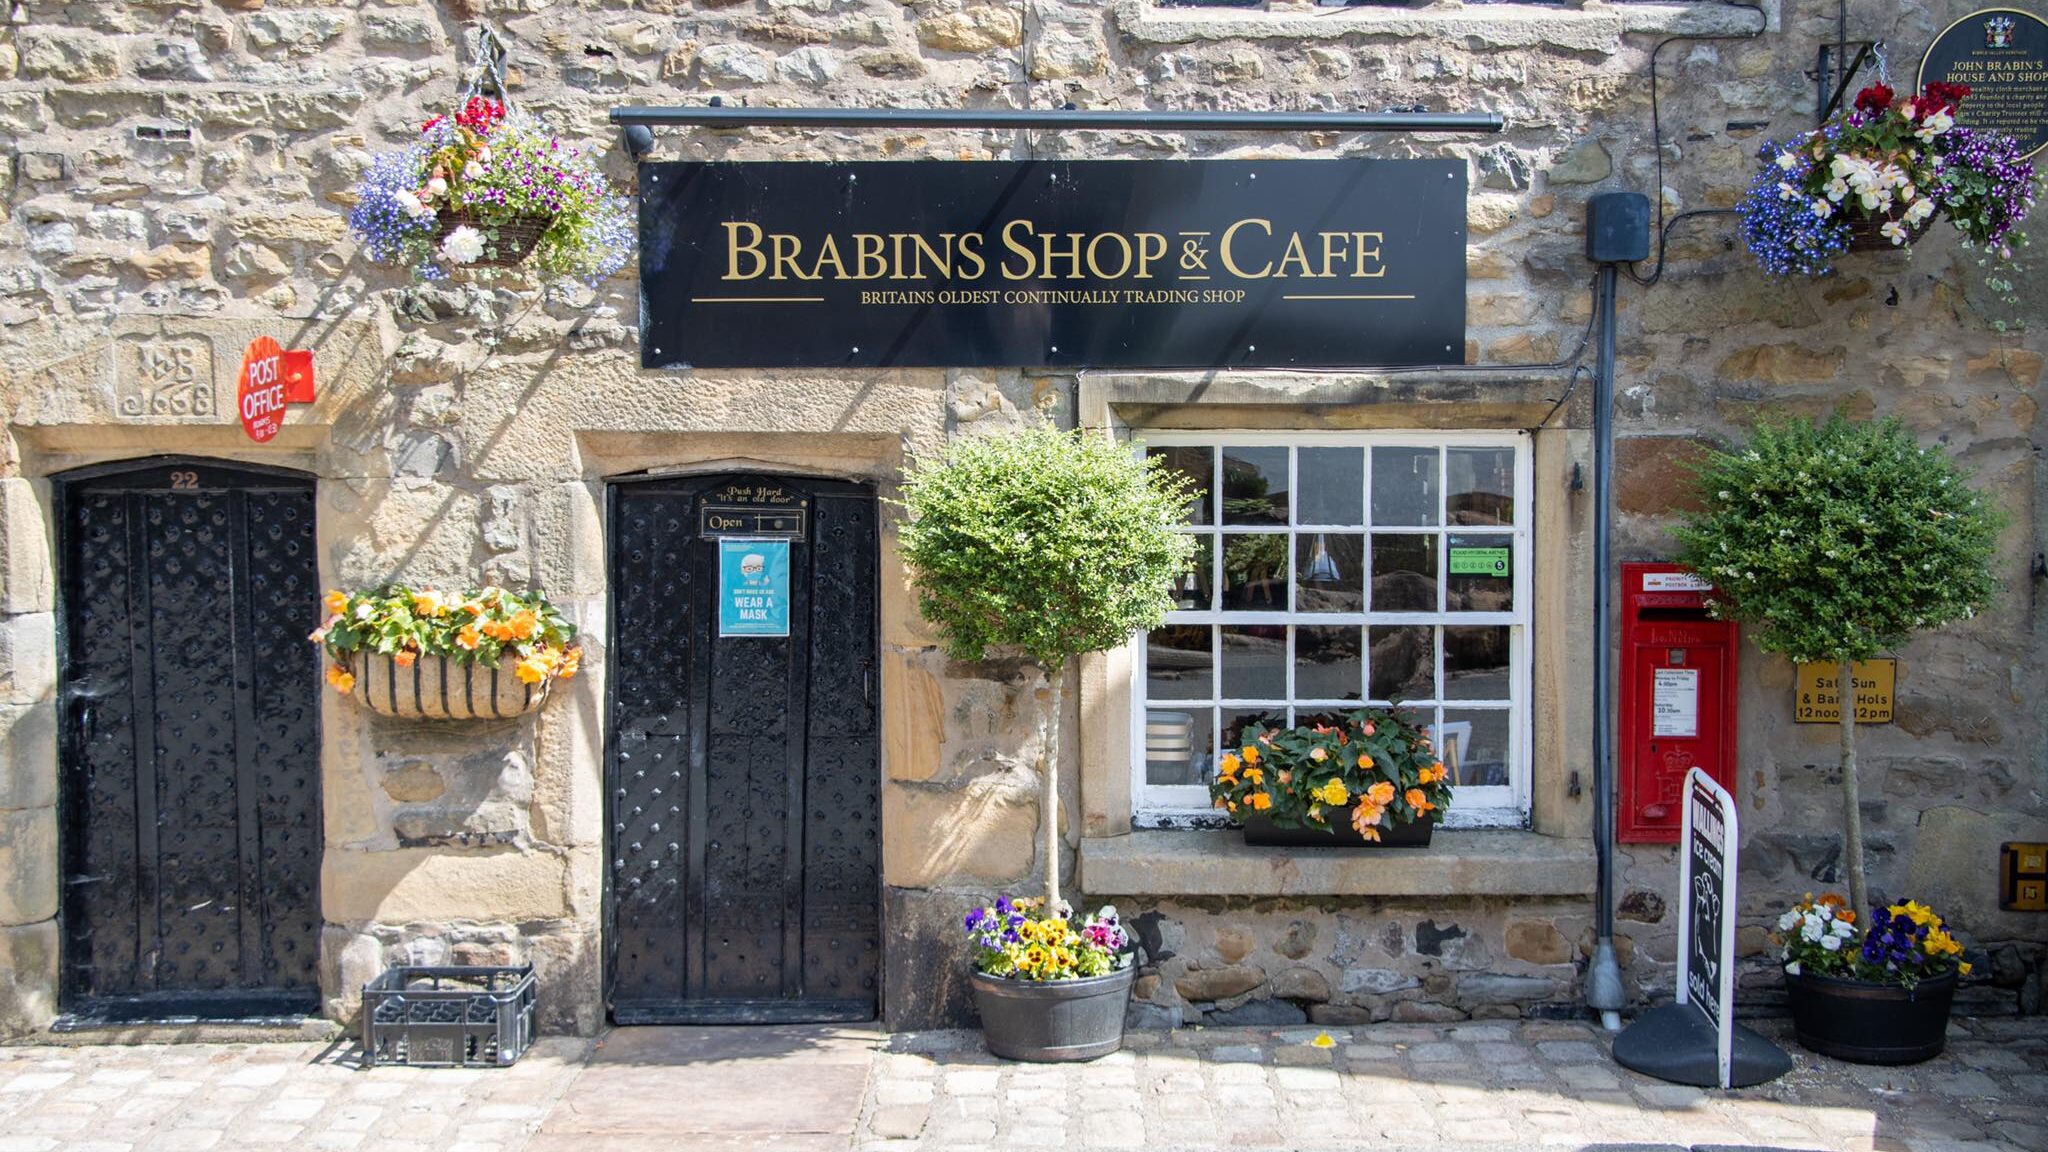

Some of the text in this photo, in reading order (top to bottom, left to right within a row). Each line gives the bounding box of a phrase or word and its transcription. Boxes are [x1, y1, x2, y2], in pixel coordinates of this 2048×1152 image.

[1953, 60, 2043, 71] JOHN BRABIN'S
[1947, 72, 2048, 83] HOUSE AND SHOP
[720, 218, 1386, 280] BRABINS SHOP & CAFE
[861, 290, 1246, 305] BRITAINS OLDEST CONTINUALLY TRADING SHOP
[249, 355, 280, 387] POST
[243, 384, 285, 420] OFFICE
[170, 472, 199, 489] 22
[727, 486, 782, 496] Push Hard
[709, 516, 743, 531] Open
[735, 596, 774, 608] WEAR A
[740, 608, 768, 620] MASK
[1852, 678, 1876, 688] Sun
[1802, 693, 1811, 704] &
[1858, 694, 1888, 704] Hols
[1692, 798, 1724, 857] WALLINGS
[1694, 831, 1722, 880] ice cream
[1689, 970, 1720, 1022] sold here
